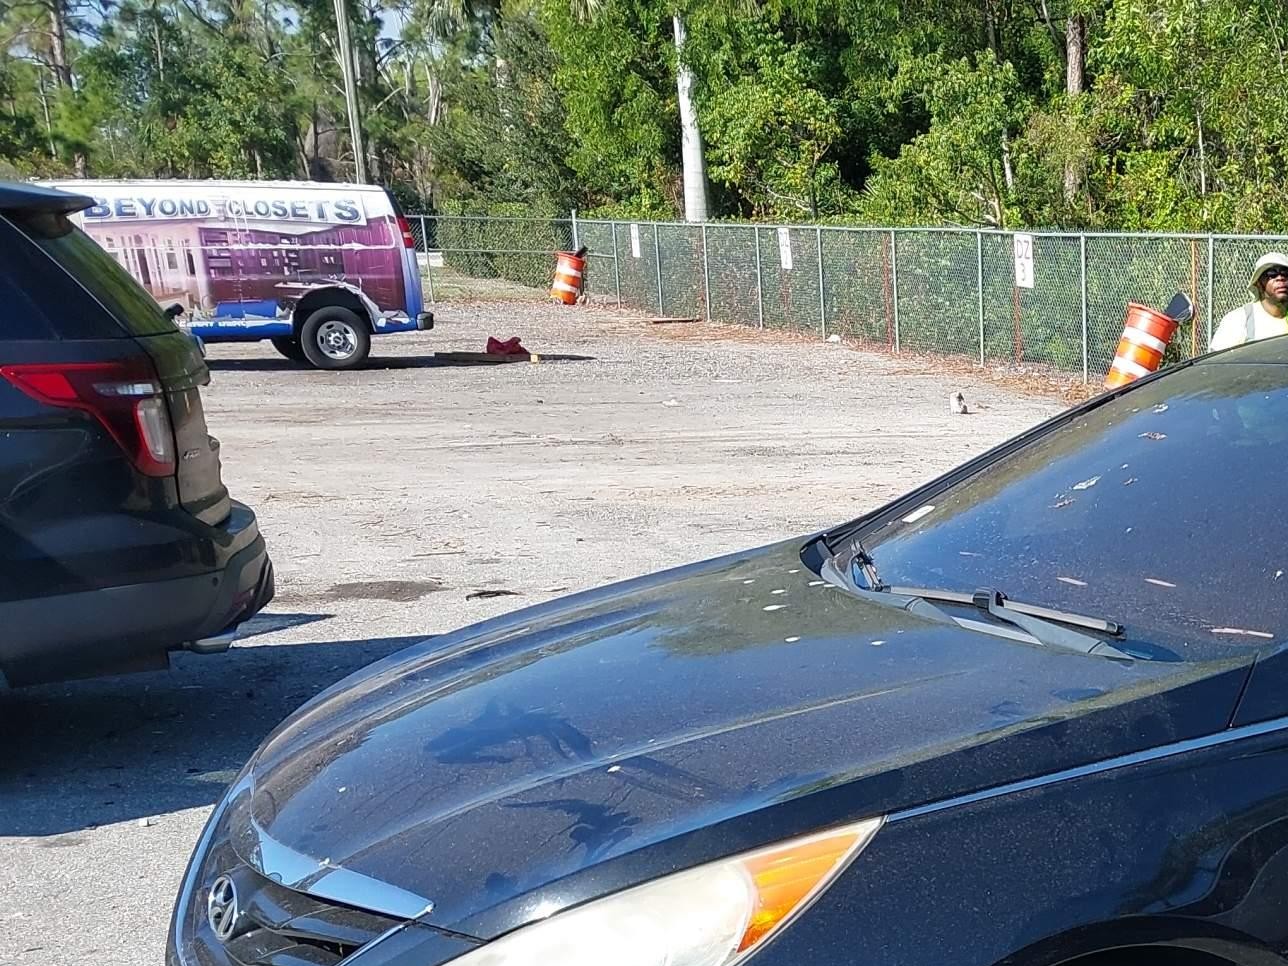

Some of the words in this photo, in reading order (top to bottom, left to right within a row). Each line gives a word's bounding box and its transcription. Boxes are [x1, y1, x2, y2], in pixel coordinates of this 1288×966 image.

[83, 196, 211, 219] BEYOND
[228, 198, 362, 224] CLOSETS
[1016, 239, 1031, 260] DZ
